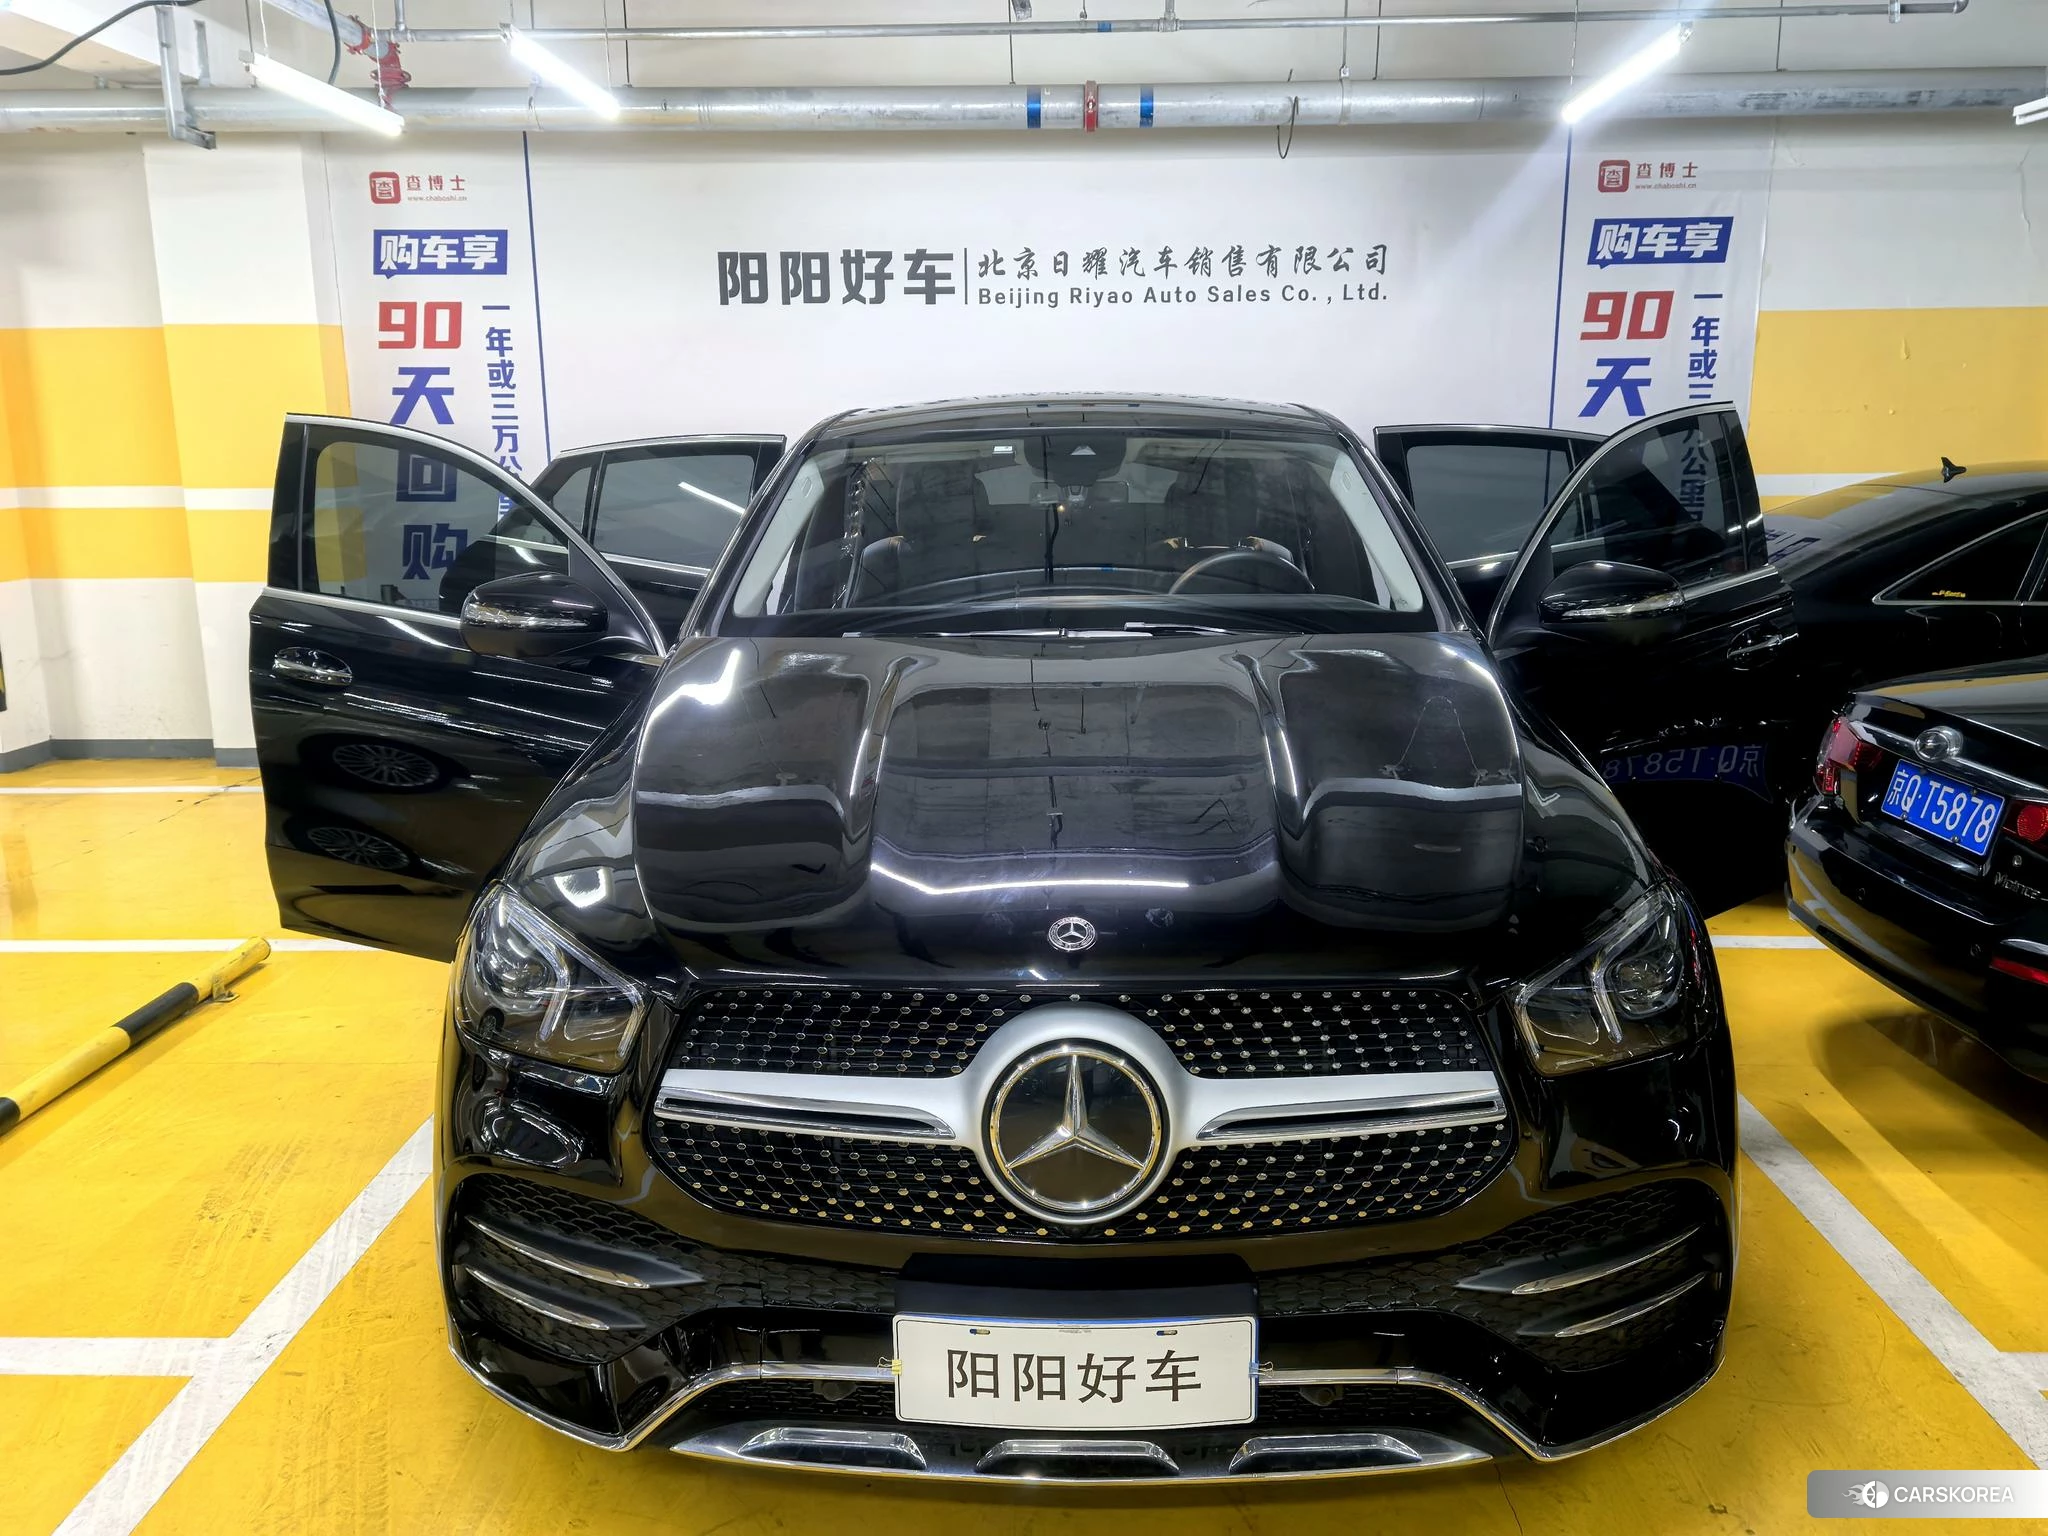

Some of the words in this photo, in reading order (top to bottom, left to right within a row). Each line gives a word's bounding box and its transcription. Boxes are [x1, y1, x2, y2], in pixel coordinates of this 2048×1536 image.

[380, 234, 500, 270] 购车享
[1595, 222, 1723, 260] 购车享
[717, 247, 956, 306] 阳阳好车
[978, 243, 1389, 281] 北京日耀汽车销售有限公司
[978, 287, 1059, 309] Beijing
[1070, 287, 1133, 308] Riyao
[1143, 286, 1197, 304] Auto
[1207, 284, 1271, 303] Sales
[1342, 281, 1388, 301] Ltd.
[947, 1349, 1202, 1404] 阳阳好车
